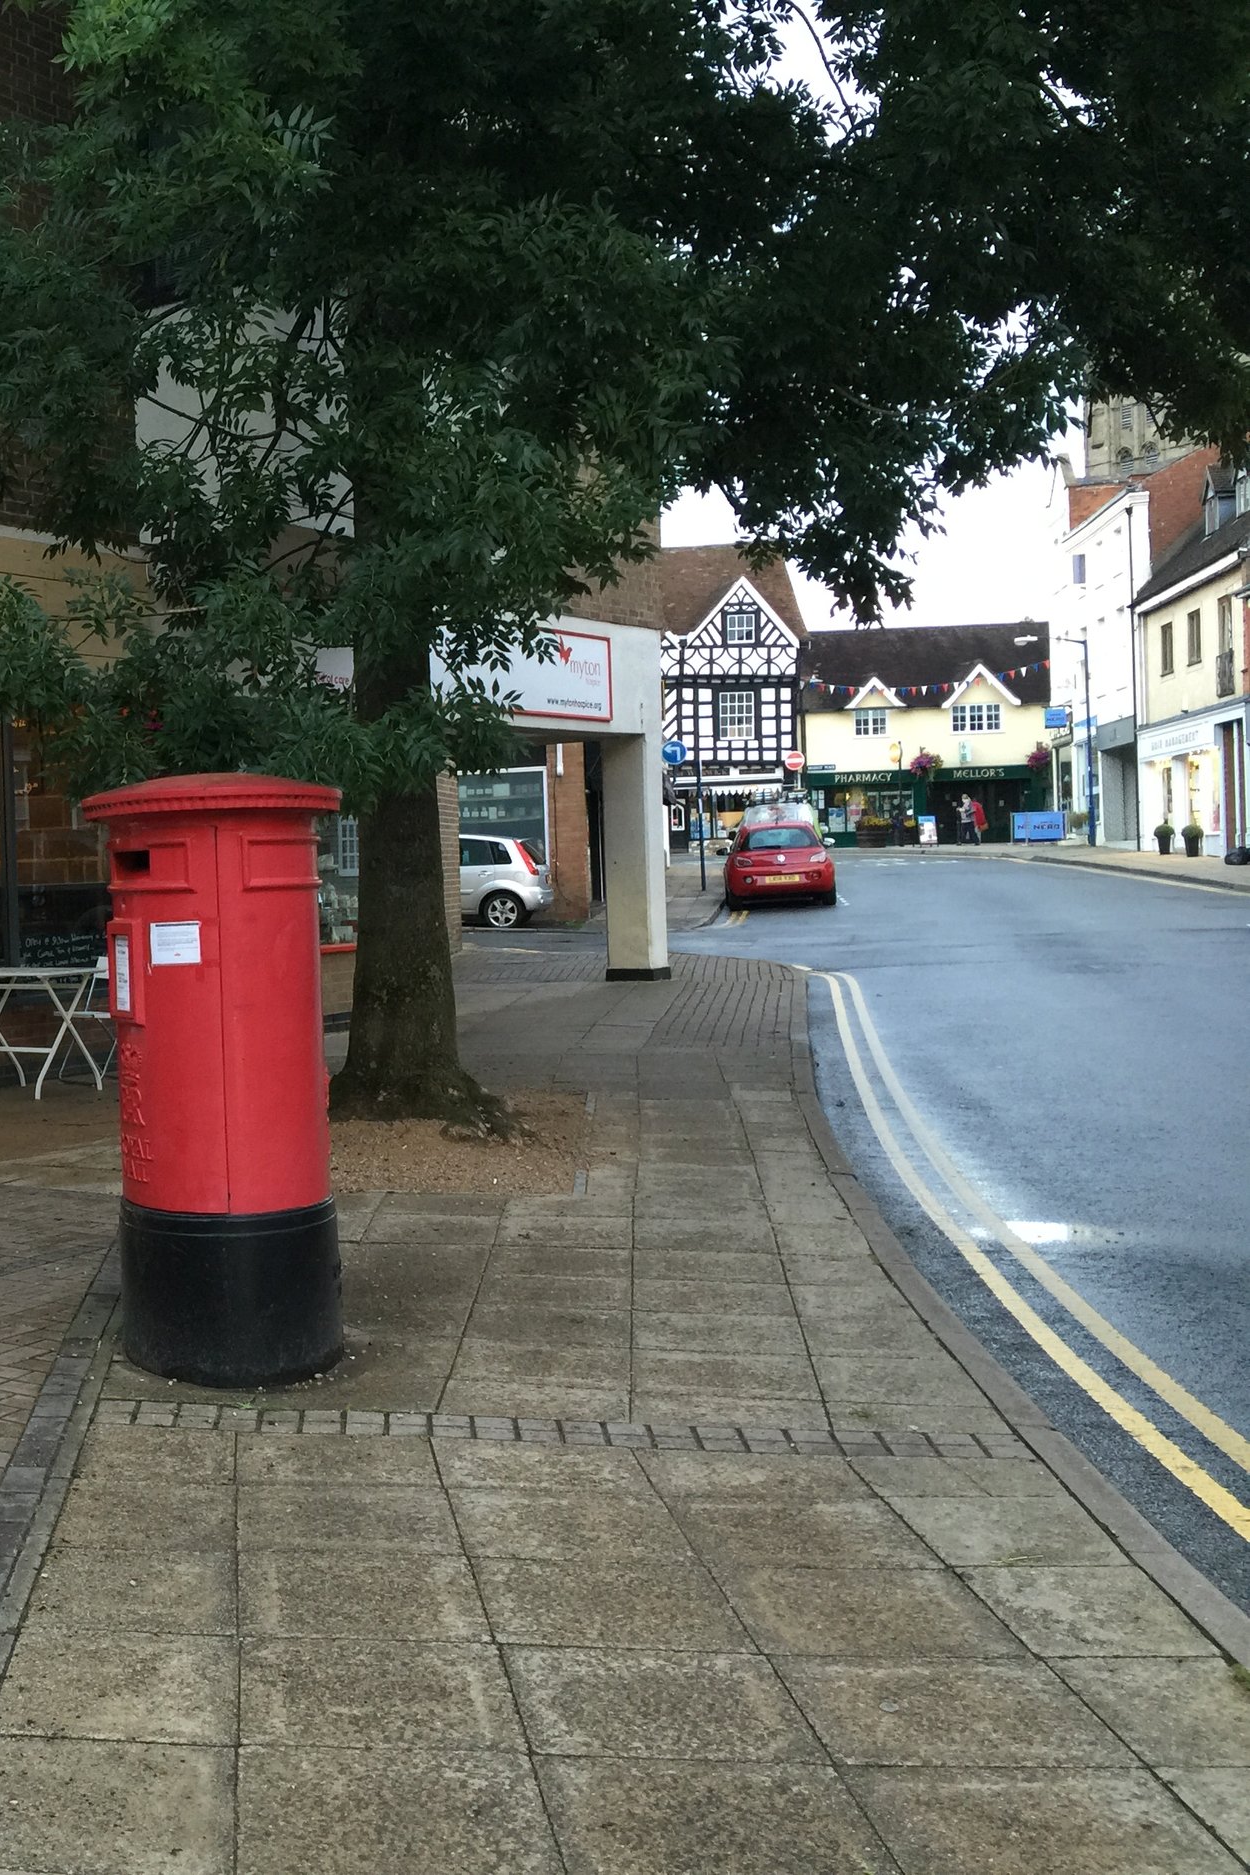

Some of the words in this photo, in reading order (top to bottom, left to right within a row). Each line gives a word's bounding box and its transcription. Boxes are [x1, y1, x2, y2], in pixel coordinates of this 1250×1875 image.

[570, 660, 601, 679] myton
[834, 772, 892, 784] PHARMACY
[953, 768, 1005, 778] MELLOR'S
